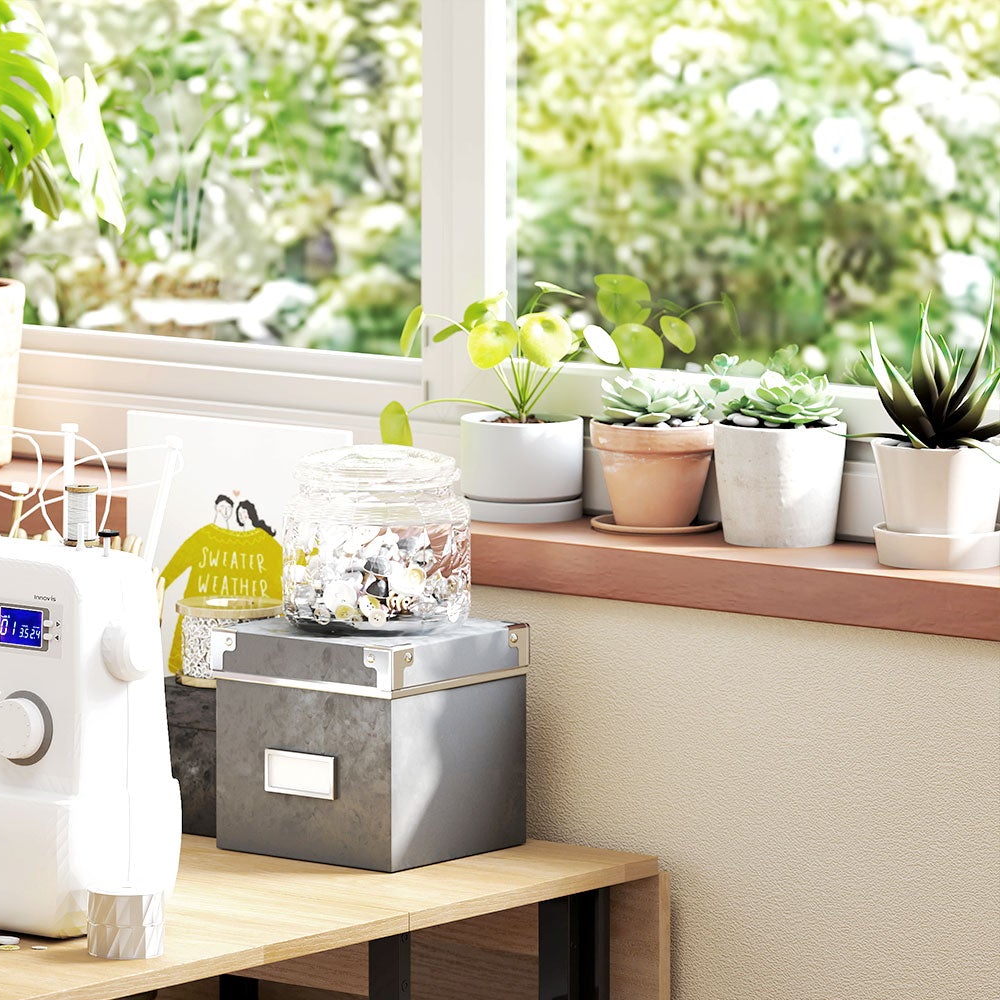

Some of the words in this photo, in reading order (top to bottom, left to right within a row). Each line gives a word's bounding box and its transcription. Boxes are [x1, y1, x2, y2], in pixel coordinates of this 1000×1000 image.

[198, 546, 267, 574] SWEATER
[197, 573, 271, 598] WEATHER
[0, 619, 16, 635] 01
